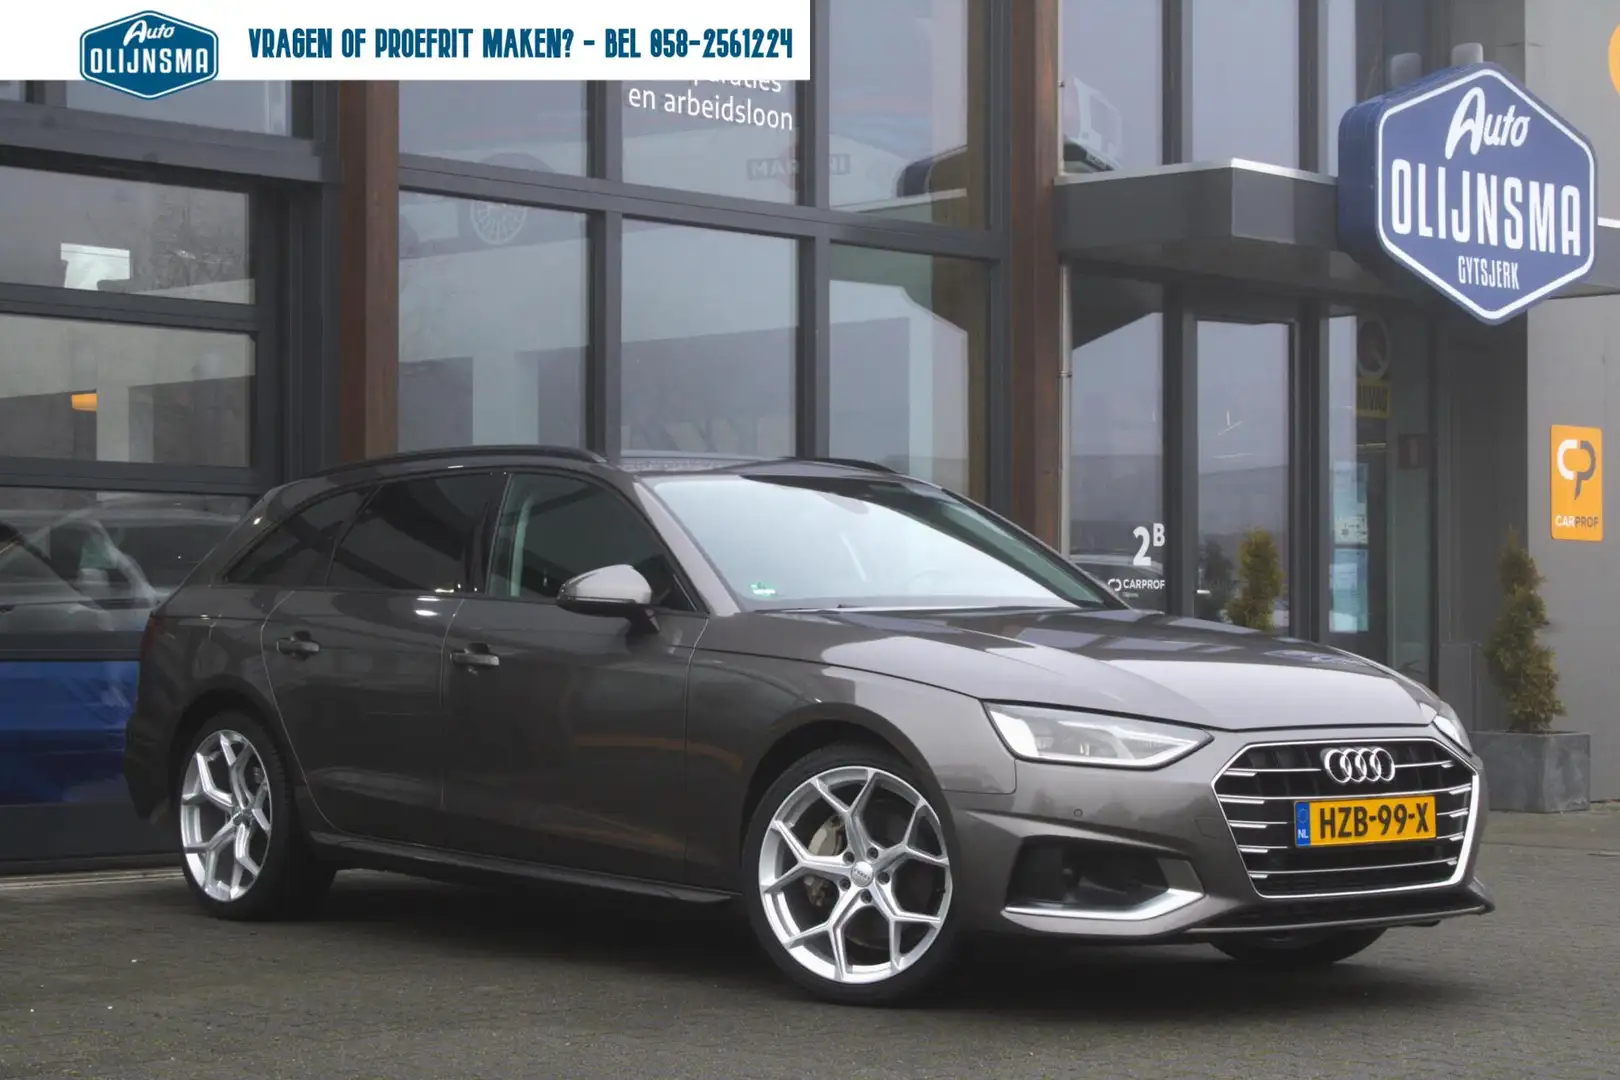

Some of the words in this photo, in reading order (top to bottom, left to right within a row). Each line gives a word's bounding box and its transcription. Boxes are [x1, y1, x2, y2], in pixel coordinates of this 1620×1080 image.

[628, 87, 656, 110] en
[664, 89, 793, 131] arbeidsloon
[1445, 86, 1531, 160] Auto
[1390, 158, 1581, 256] OLIJNSMA
[1457, 255, 1520, 290] GYTSJERK
[1555, 515, 1599, 529] CARPROF
[1122, 578, 1166, 590] CARPROF
[1297, 828, 1309, 839] NL
[1319, 802, 1429, 839] HZB-99-X
